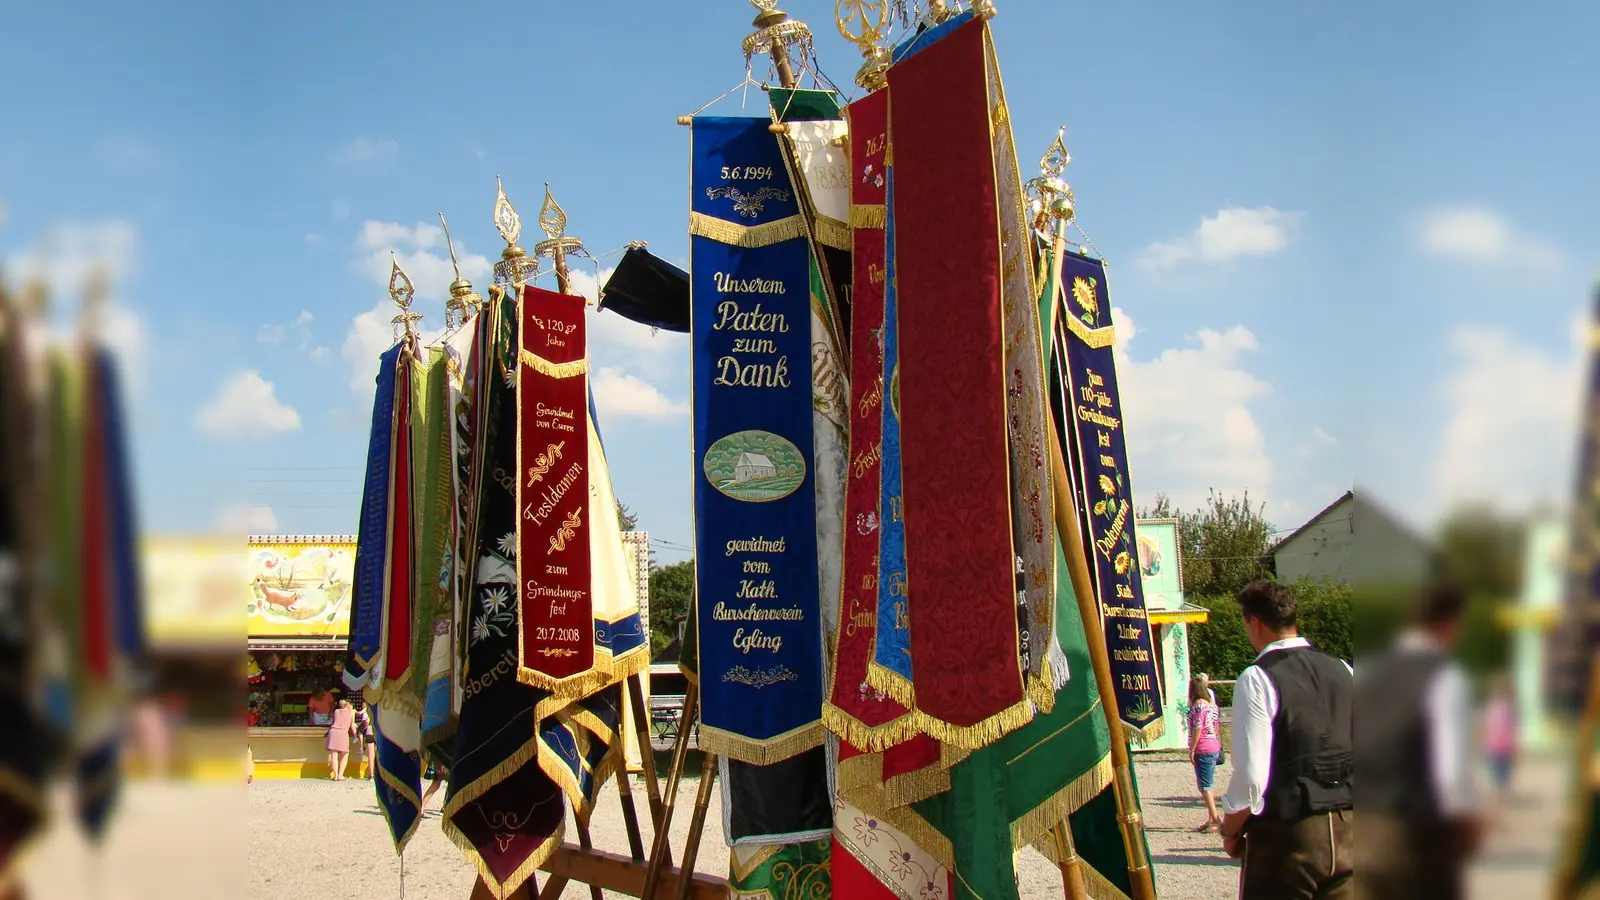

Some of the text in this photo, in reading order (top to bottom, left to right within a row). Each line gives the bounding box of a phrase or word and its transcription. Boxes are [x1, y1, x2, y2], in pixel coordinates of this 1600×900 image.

[865, 132, 886, 158] 26.7.
[720, 166, 774, 181] 5.6.1994
[713, 271, 786, 295] Unserem
[547, 318, 564, 332] 120
[713, 300, 789, 333] Paten
[731, 337, 777, 354] zum
[713, 354, 791, 388] Dank
[859, 372, 883, 418] Fest
[536, 402, 574, 420] Gewidmet
[536, 417, 575, 432] von Euren
[853, 441, 881, 478] Fest
[523, 461, 583, 527] Festdamen
[725, 536, 786, 556] gewidmet
[545, 564, 568, 576] zum
[742, 560, 771, 574] vom
[526, 580, 587, 602] Gründungs-
[736, 579, 778, 599] Kath.
[549, 600, 567, 618] fest
[712, 601, 804, 621] Burschenverein
[536, 626, 580, 642] 20.7.2008
[732, 628, 783, 654] Egling
[1121, 674, 1151, 691] 7.8.2011
